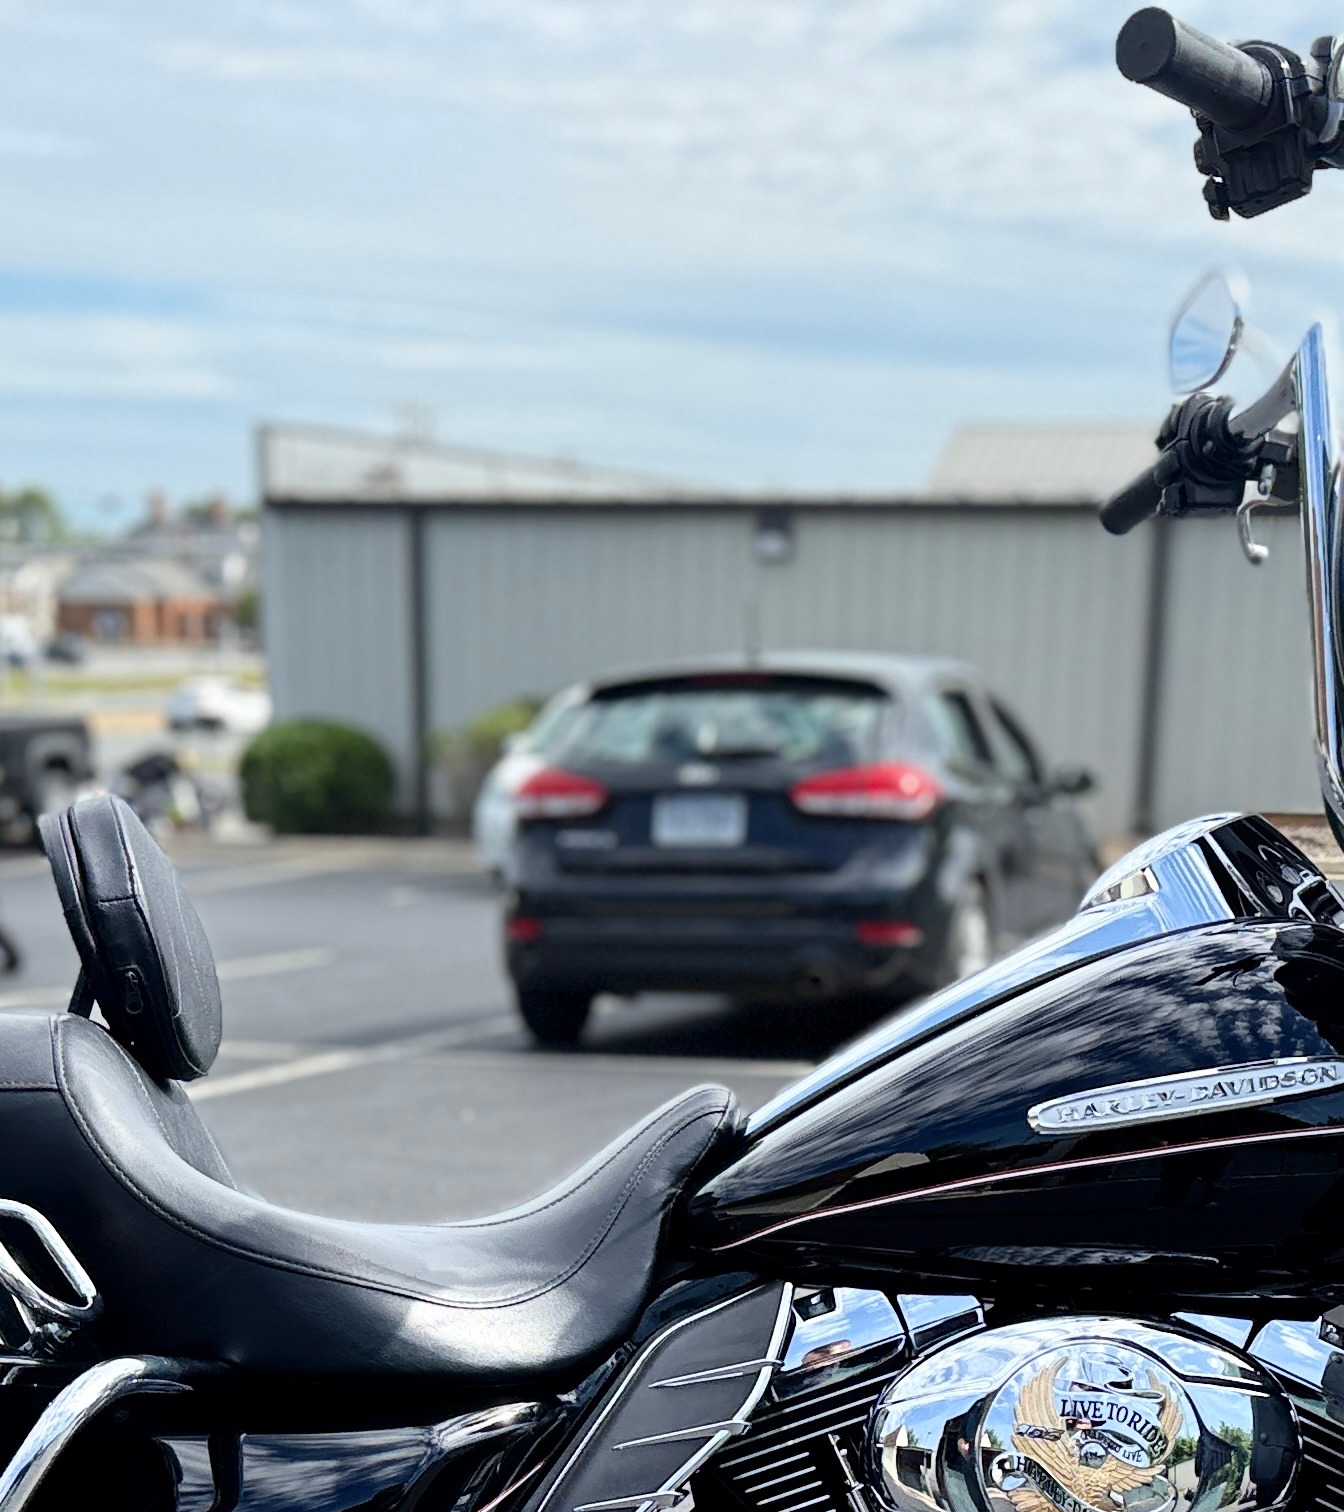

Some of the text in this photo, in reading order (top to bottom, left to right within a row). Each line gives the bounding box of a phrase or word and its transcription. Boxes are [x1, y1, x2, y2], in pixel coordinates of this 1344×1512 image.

[1056, 1064, 1340, 1123] HARLEY-DAVIDSON
[1059, 1398, 1168, 1456] LIVE TO RIDE
